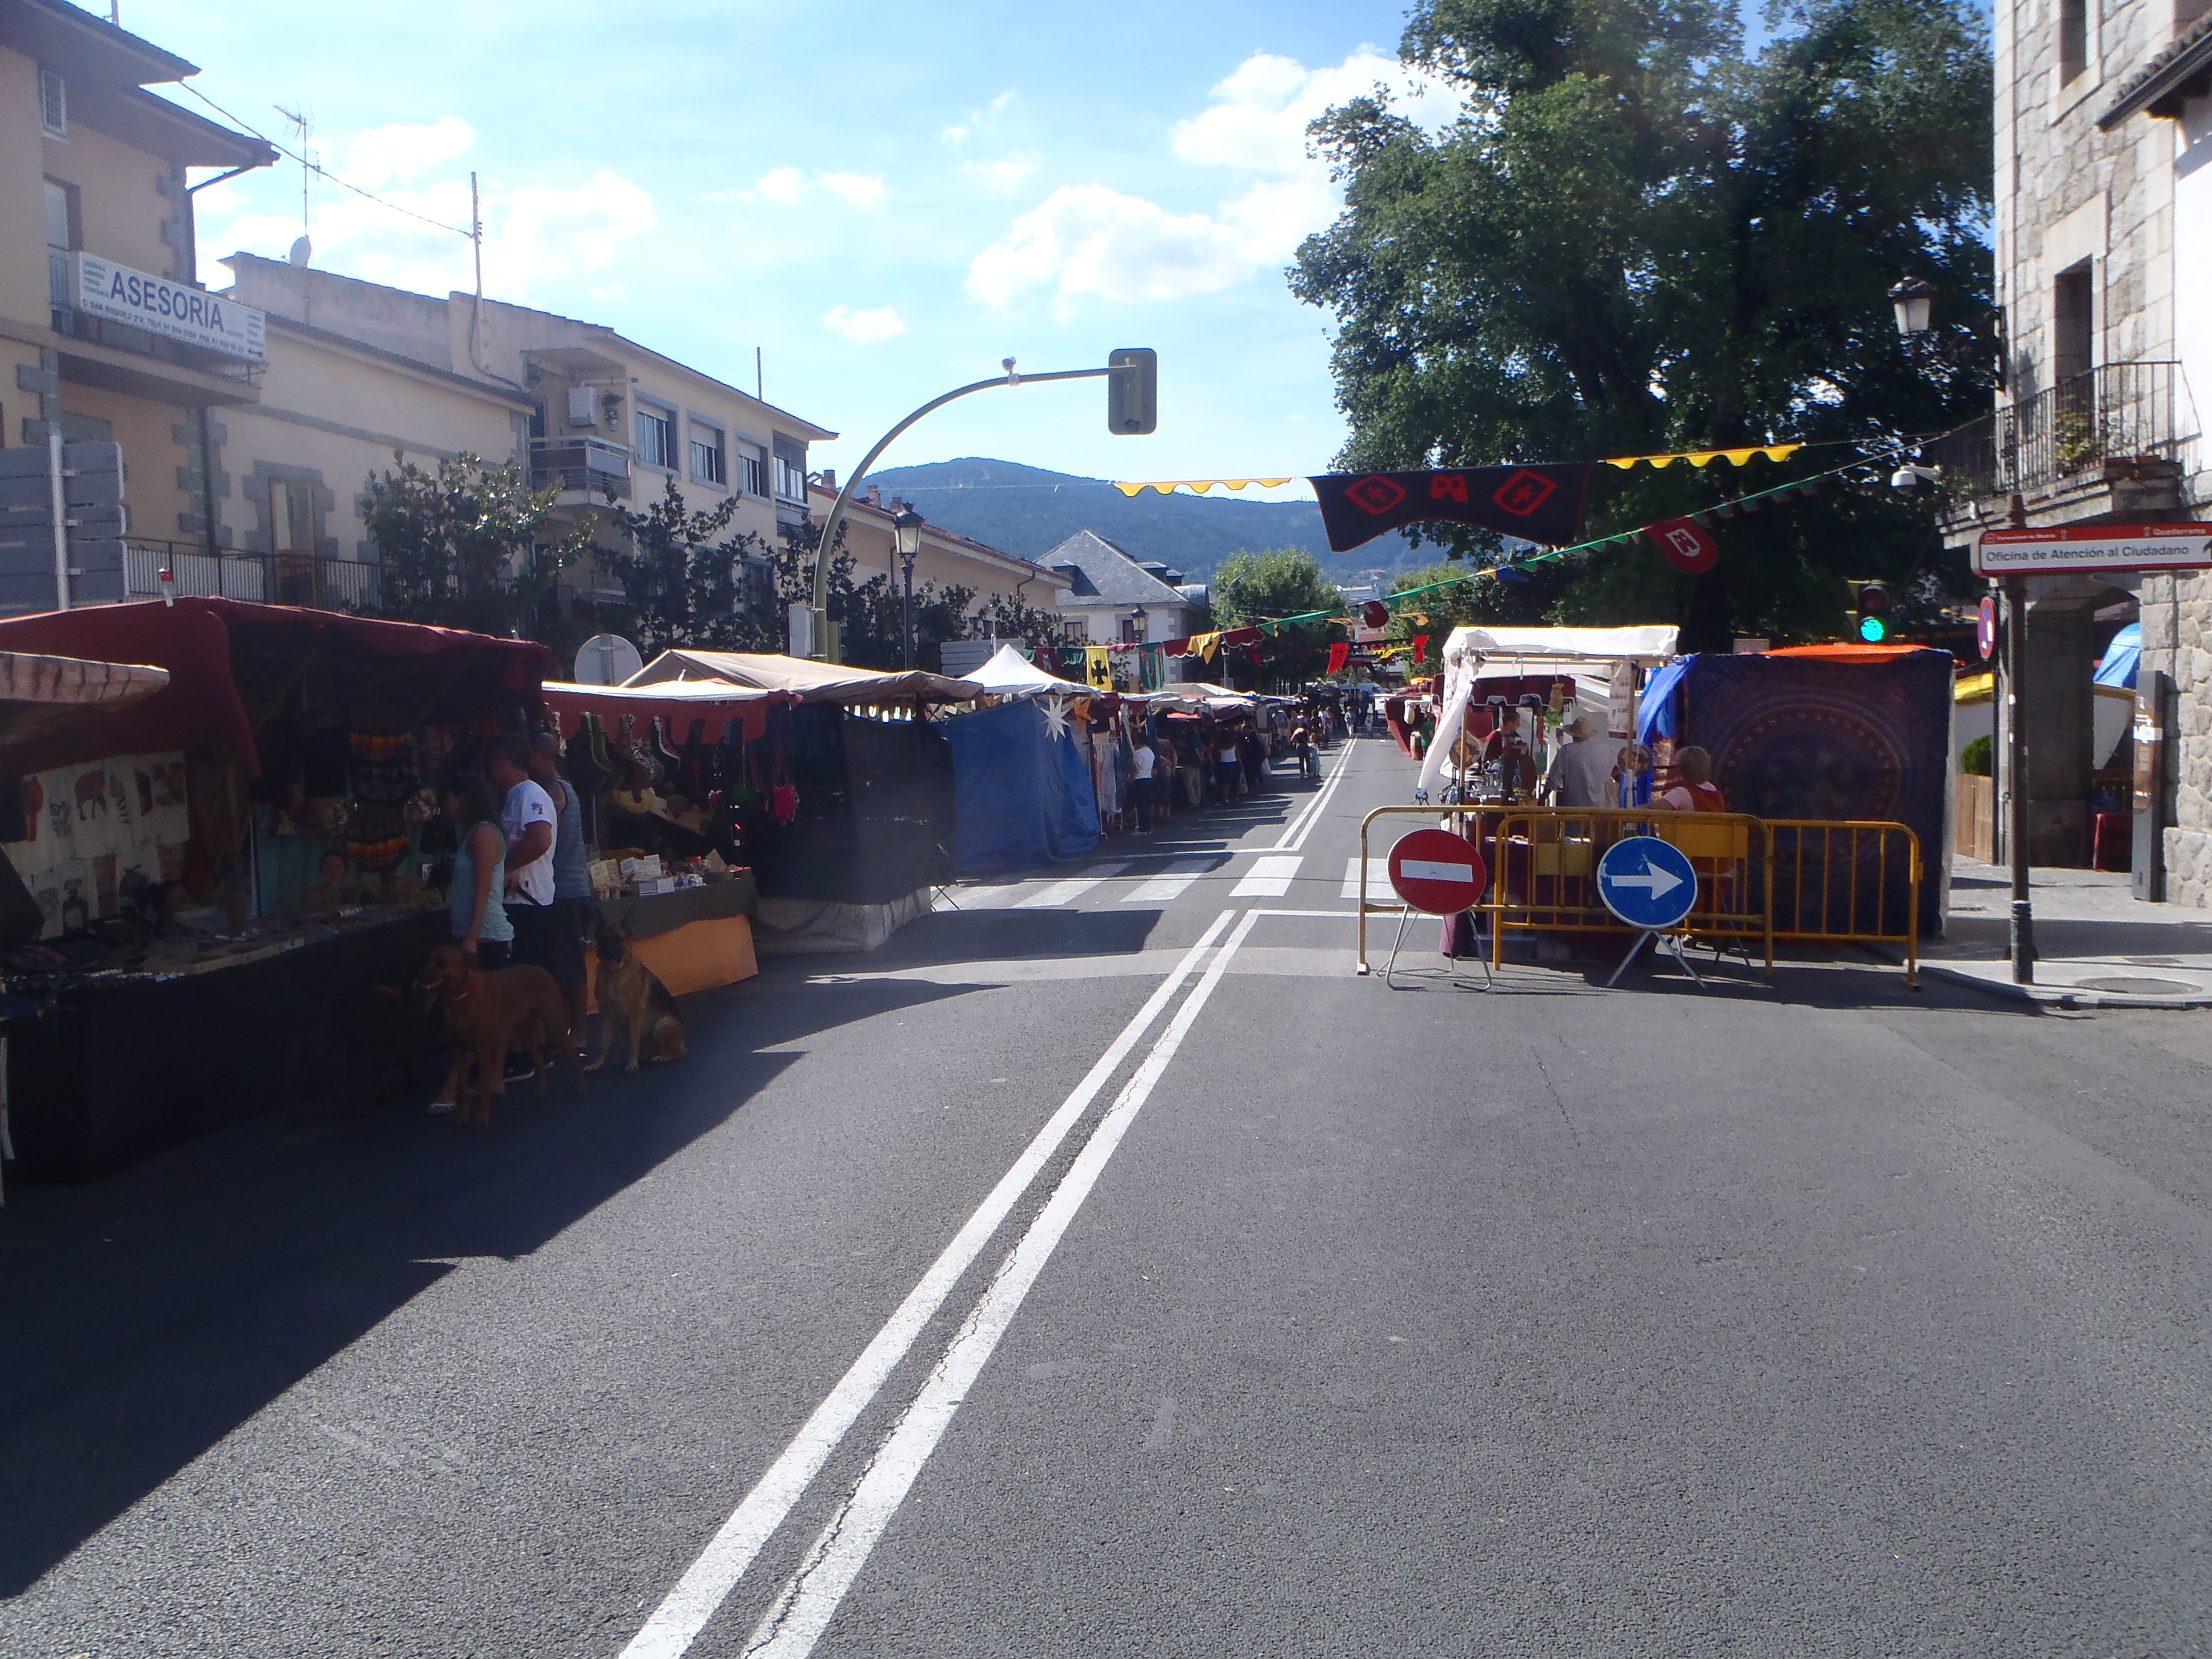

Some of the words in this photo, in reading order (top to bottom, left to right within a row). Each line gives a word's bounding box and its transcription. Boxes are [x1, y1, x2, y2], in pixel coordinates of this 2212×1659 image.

[1986, 551, 2029, 562] Oficina
[2032, 550, 2047, 560] de
[2107, 547, 2119, 558] al
[2122, 545, 2189, 557] Ciudadano
